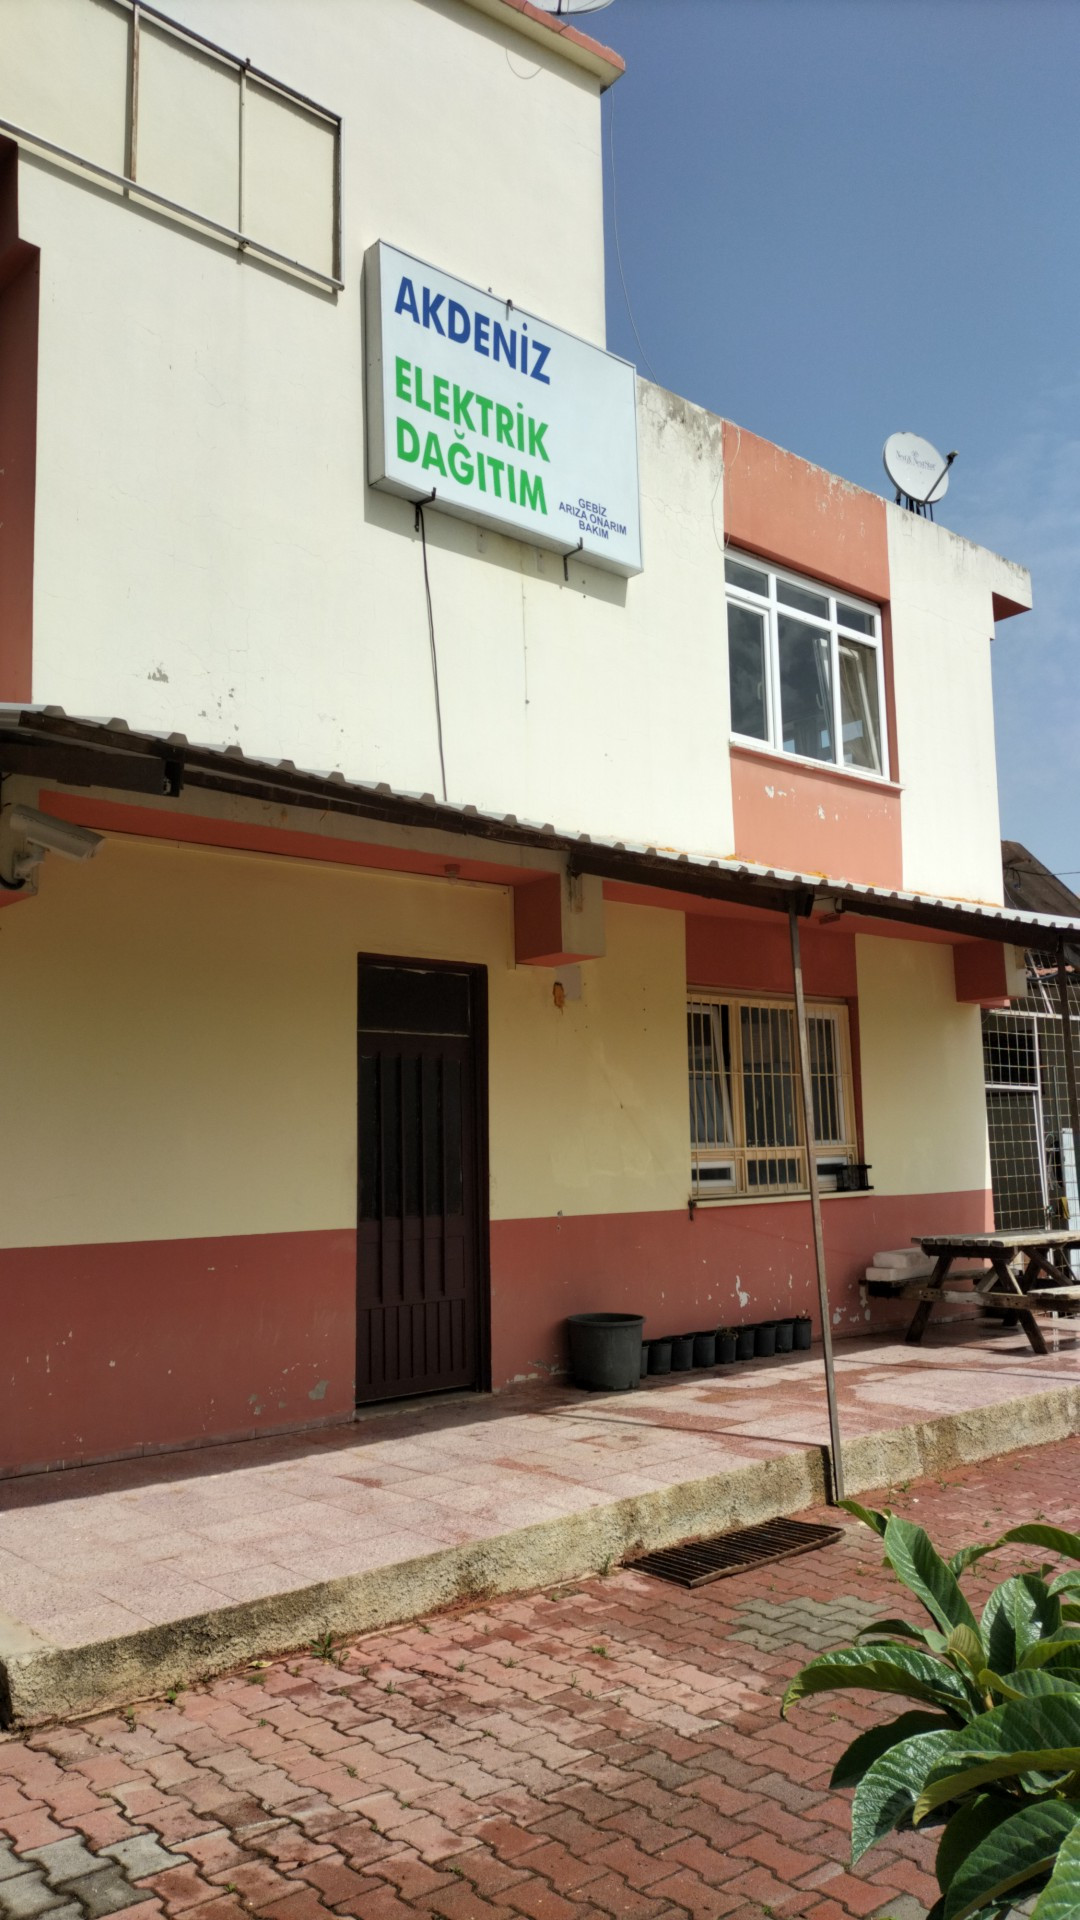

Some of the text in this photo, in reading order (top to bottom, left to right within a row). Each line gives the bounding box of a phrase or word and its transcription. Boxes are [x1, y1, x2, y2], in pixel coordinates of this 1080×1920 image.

[394, 276, 551, 385] AKDENİZ
[395, 356, 550, 463] ELEKTRİK
[396, 416, 548, 516] DAĞITIM
[559, 501, 627, 536] ARIZA ONARIM
[578, 498, 607, 518] GEBİZ
[578, 519, 609, 540] BAKIM
